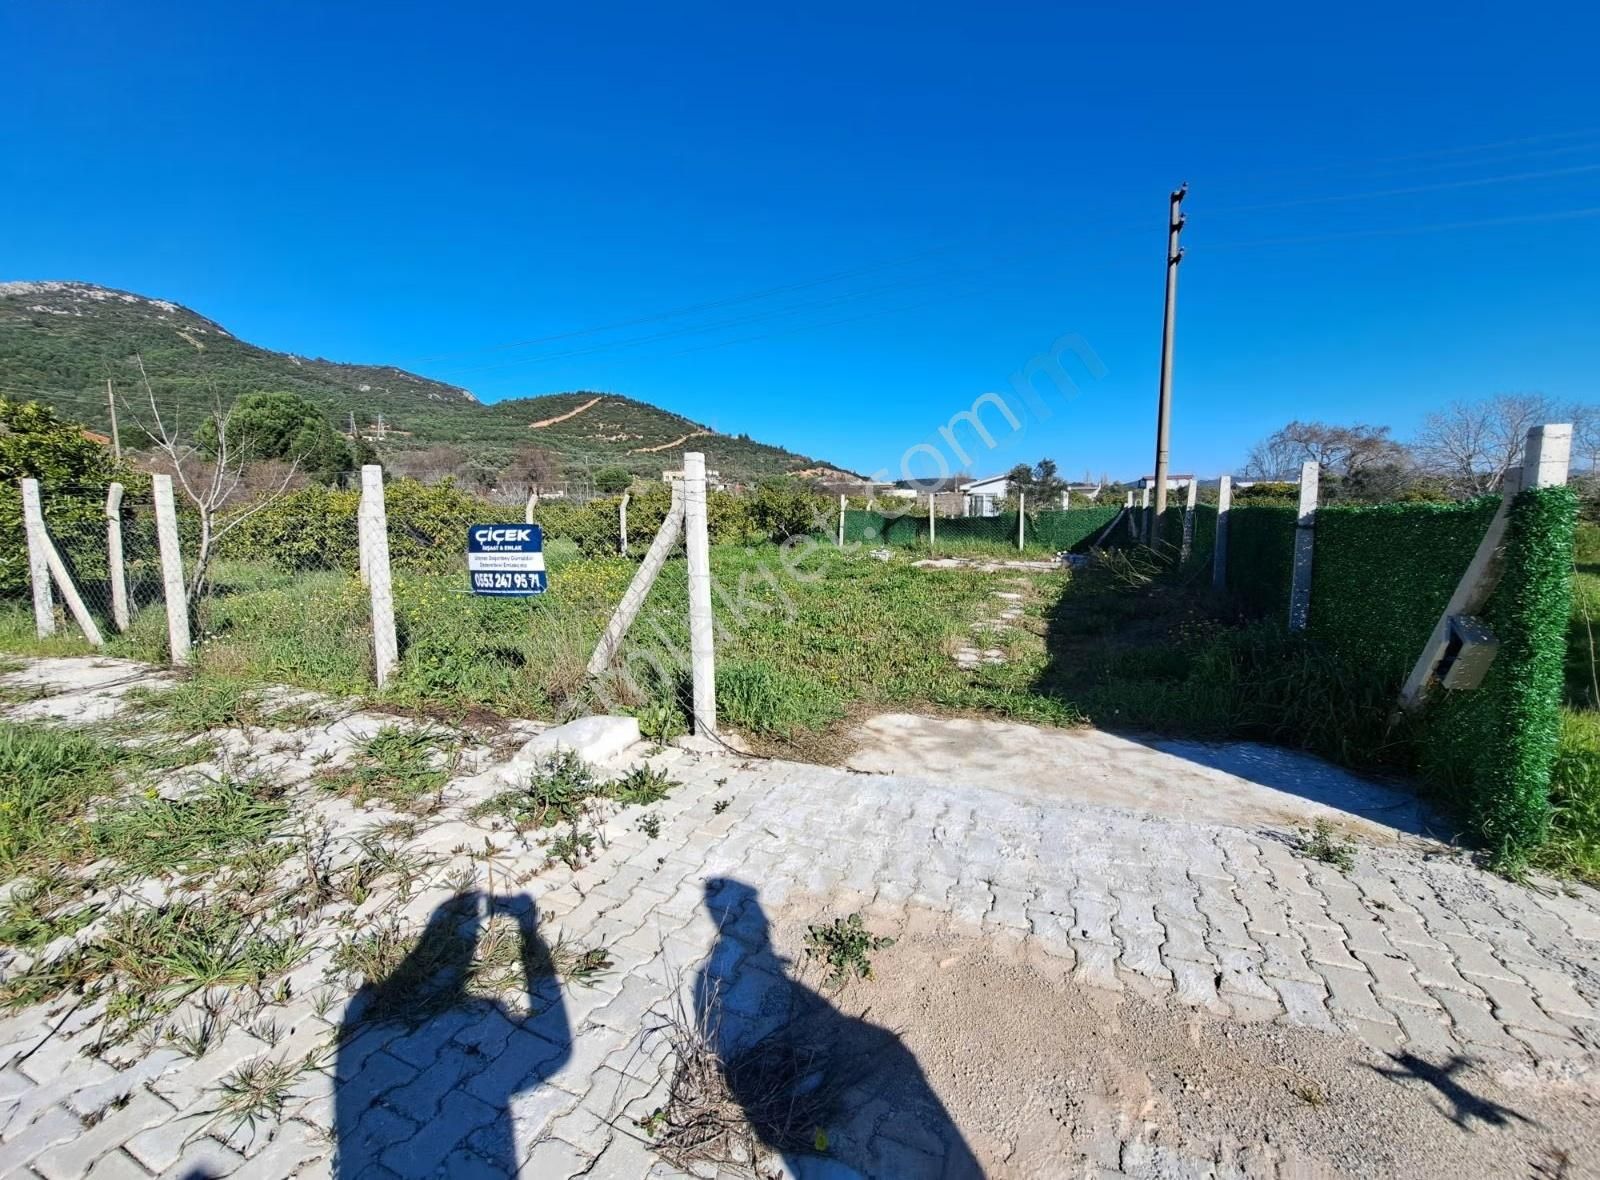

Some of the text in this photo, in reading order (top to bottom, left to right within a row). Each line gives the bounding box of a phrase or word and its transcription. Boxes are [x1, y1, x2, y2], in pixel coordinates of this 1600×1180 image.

[475, 527, 532, 546] ÇİÇEK
[495, 573, 512, 588] 247
[514, 573, 528, 588] 95
[528, 573, 540, 588] 71
